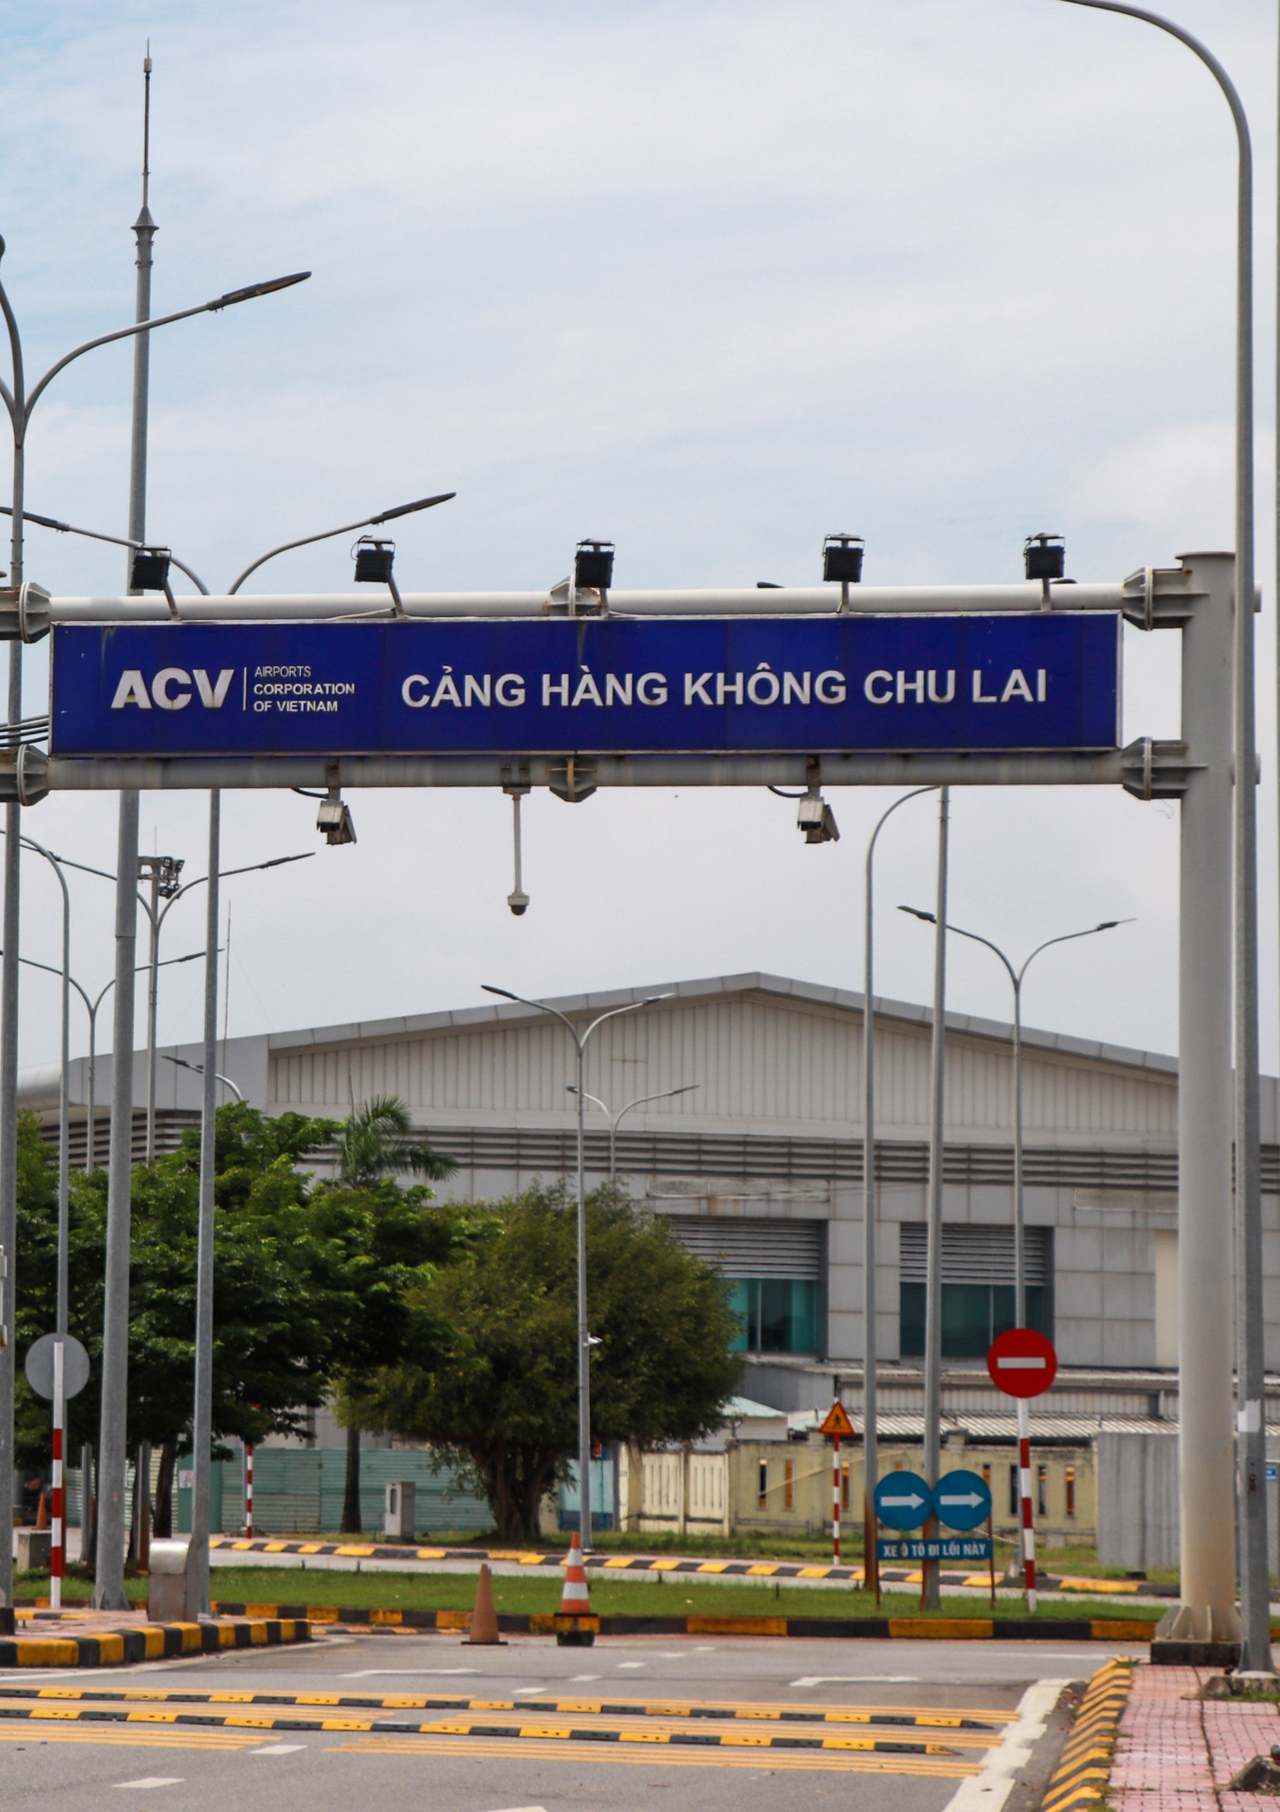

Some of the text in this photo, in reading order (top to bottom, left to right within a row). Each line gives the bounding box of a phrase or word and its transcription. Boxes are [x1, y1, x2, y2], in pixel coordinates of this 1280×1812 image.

[254, 665, 312, 678] AIRPORTS
[110, 667, 235, 711] ACV
[253, 683, 356, 696] CORPORATION
[401, 661, 1047, 708] CẢNG HÀNG KHÔNG CHU LAI
[253, 700, 338, 712] OF VIETNAM
[883, 1545, 898, 1557] XE
[911, 1542, 926, 1557] TÔ
[963, 1541, 986, 1555] NÀY
